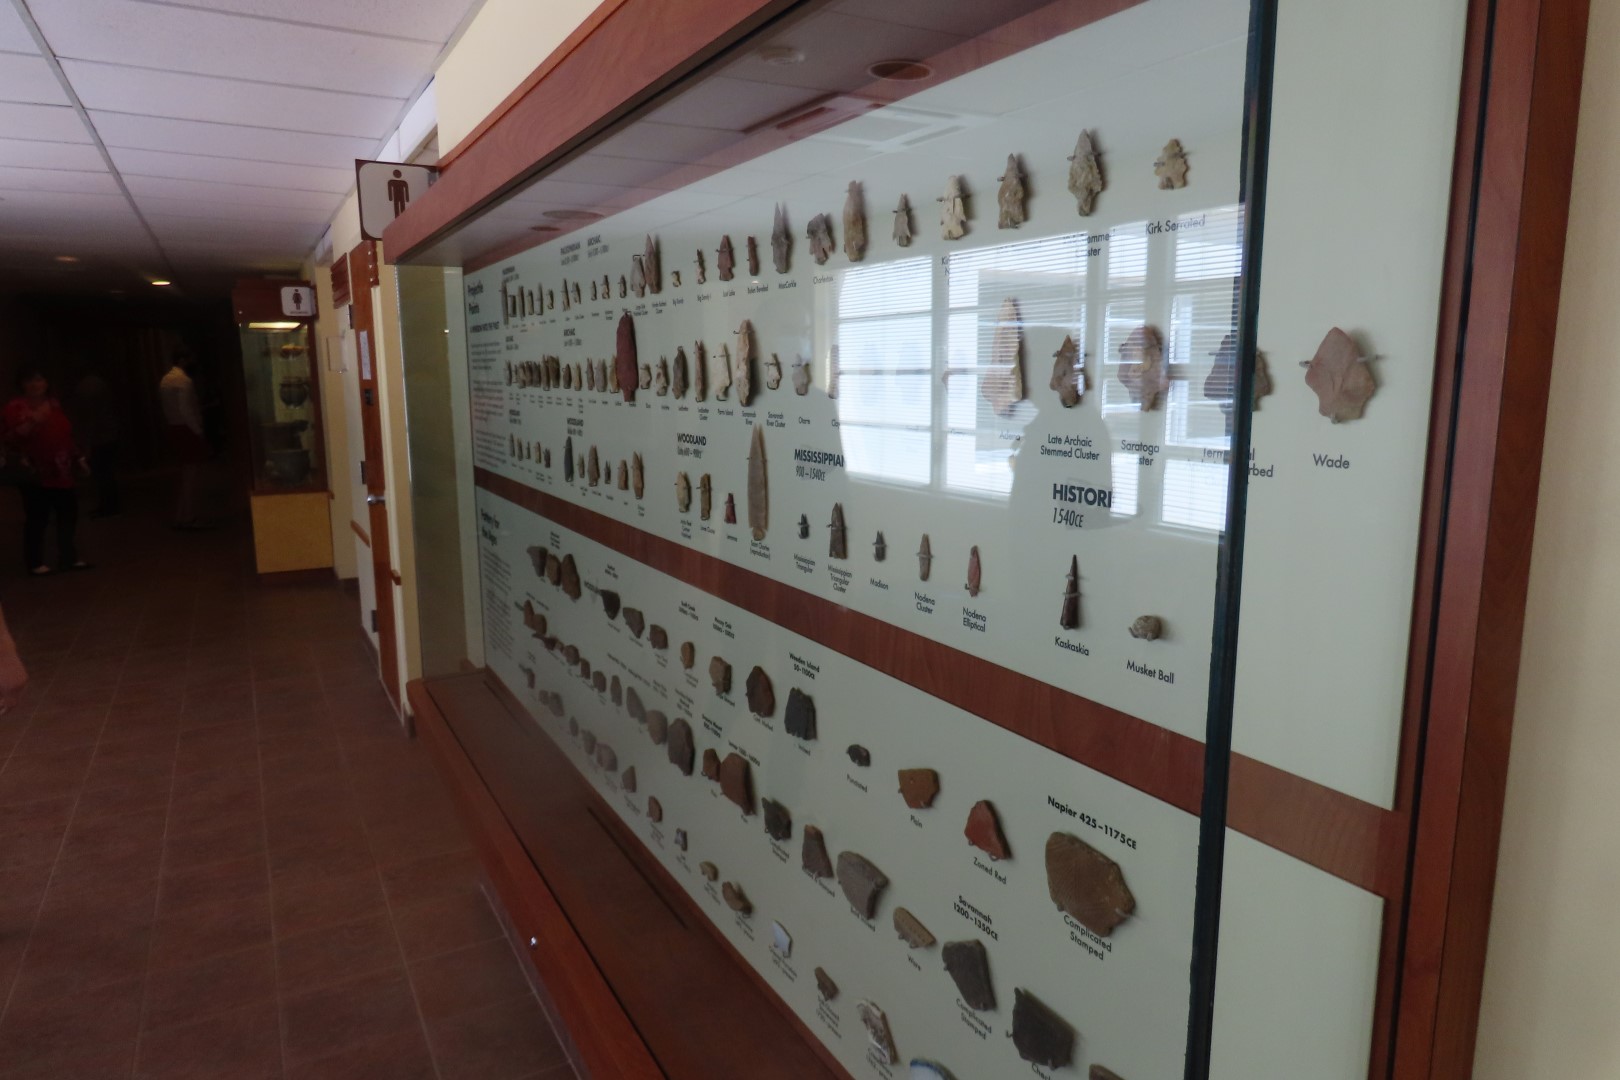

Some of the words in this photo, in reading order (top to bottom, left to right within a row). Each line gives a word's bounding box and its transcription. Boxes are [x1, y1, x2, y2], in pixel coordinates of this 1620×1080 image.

[1146, 220, 1162, 235] Kirk
[677, 432, 707, 447] WOODLAND
[1047, 433, 1063, 445] Late
[1063, 435, 1093, 447] Archaic
[1120, 439, 1160, 456] Saratoga
[1040, 445, 1073, 458] Stemmed
[1074, 448, 1100, 461] Cluster
[1312, 453, 1350, 469] Wade
[1052, 483, 1114, 509] HISTORI
[1052, 507, 1084, 528] 1540CE
[870, 578, 889, 590] Madison
[914, 592, 936, 606] Nodena
[916, 603, 934, 615] Cluster
[962, 606, 987, 622] Nodena
[962, 617, 986, 633] Elliptical
[1054, 636, 1090, 656] Kaskaskia
[1126, 659, 1157, 678] Musket
[1157, 669, 1175, 684] Ball
[1047, 795, 1078, 818] Napier
[973, 856, 993, 877] Zoned
[994, 870, 1007, 885] Red
[958, 895, 992, 925] Savannah
[1063, 914, 1112, 953] Complicated
[1069, 931, 1104, 961] Stamped
